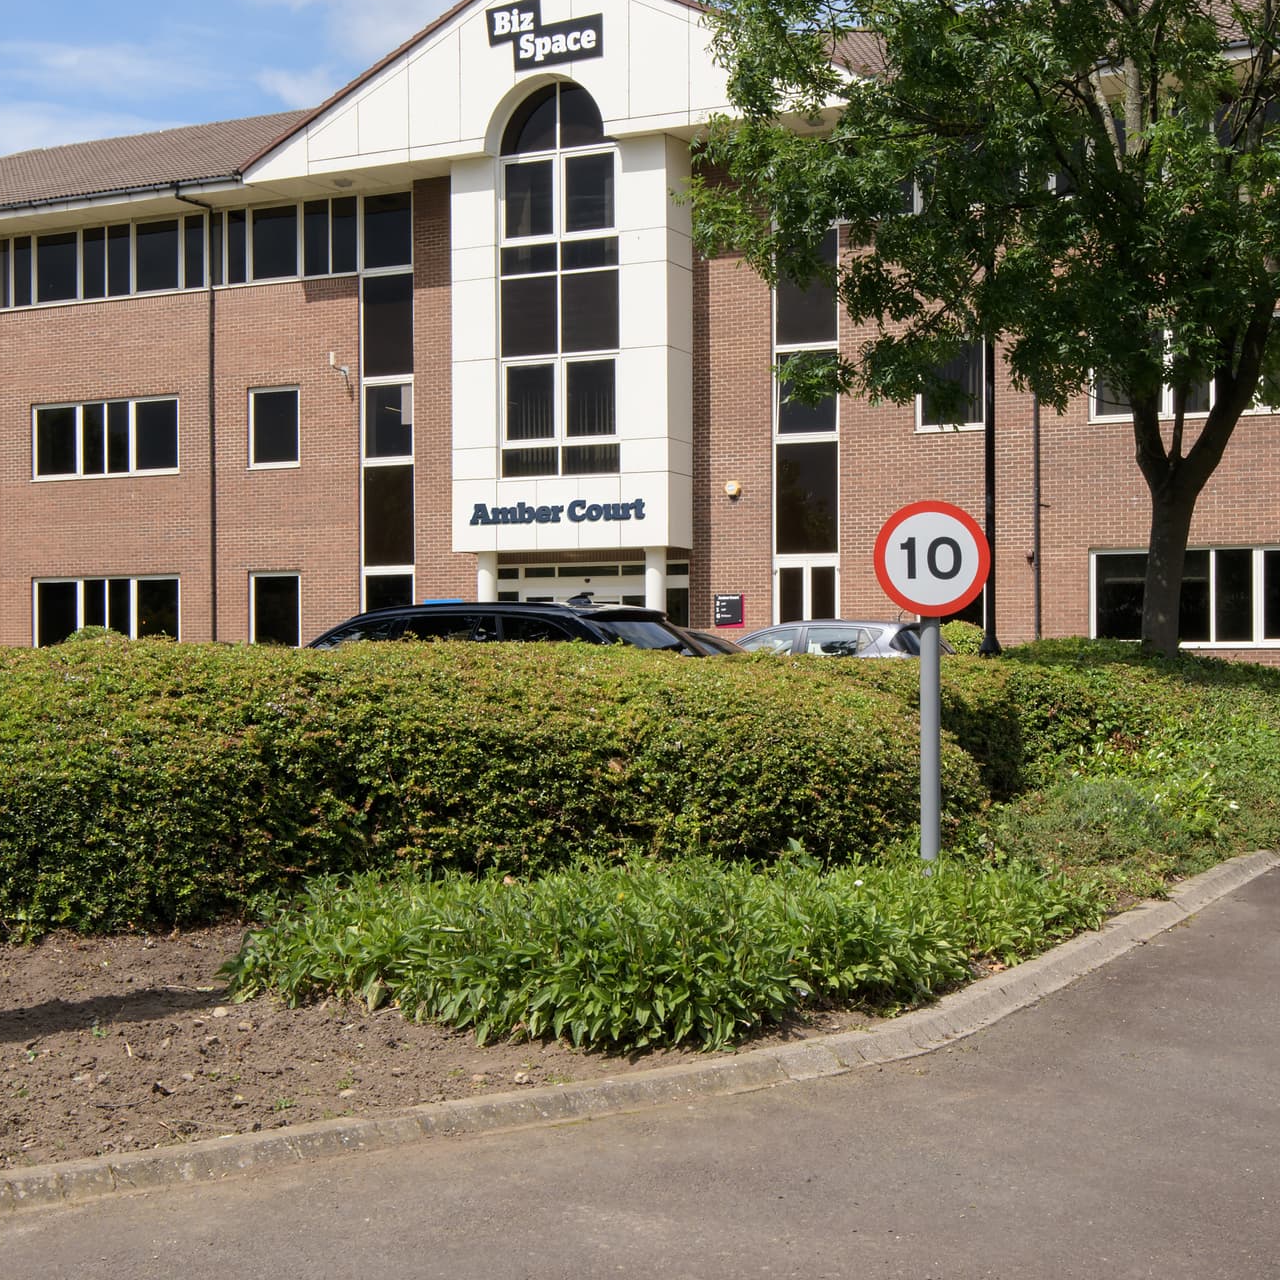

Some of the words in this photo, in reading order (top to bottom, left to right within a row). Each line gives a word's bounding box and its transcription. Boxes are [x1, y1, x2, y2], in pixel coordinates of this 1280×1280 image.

[494, 8, 535, 36] Biz
[520, 29, 597, 61] Space
[470, 501, 565, 526] Amber
[567, 498, 646, 523] Court
[900, 536, 963, 581] 10
